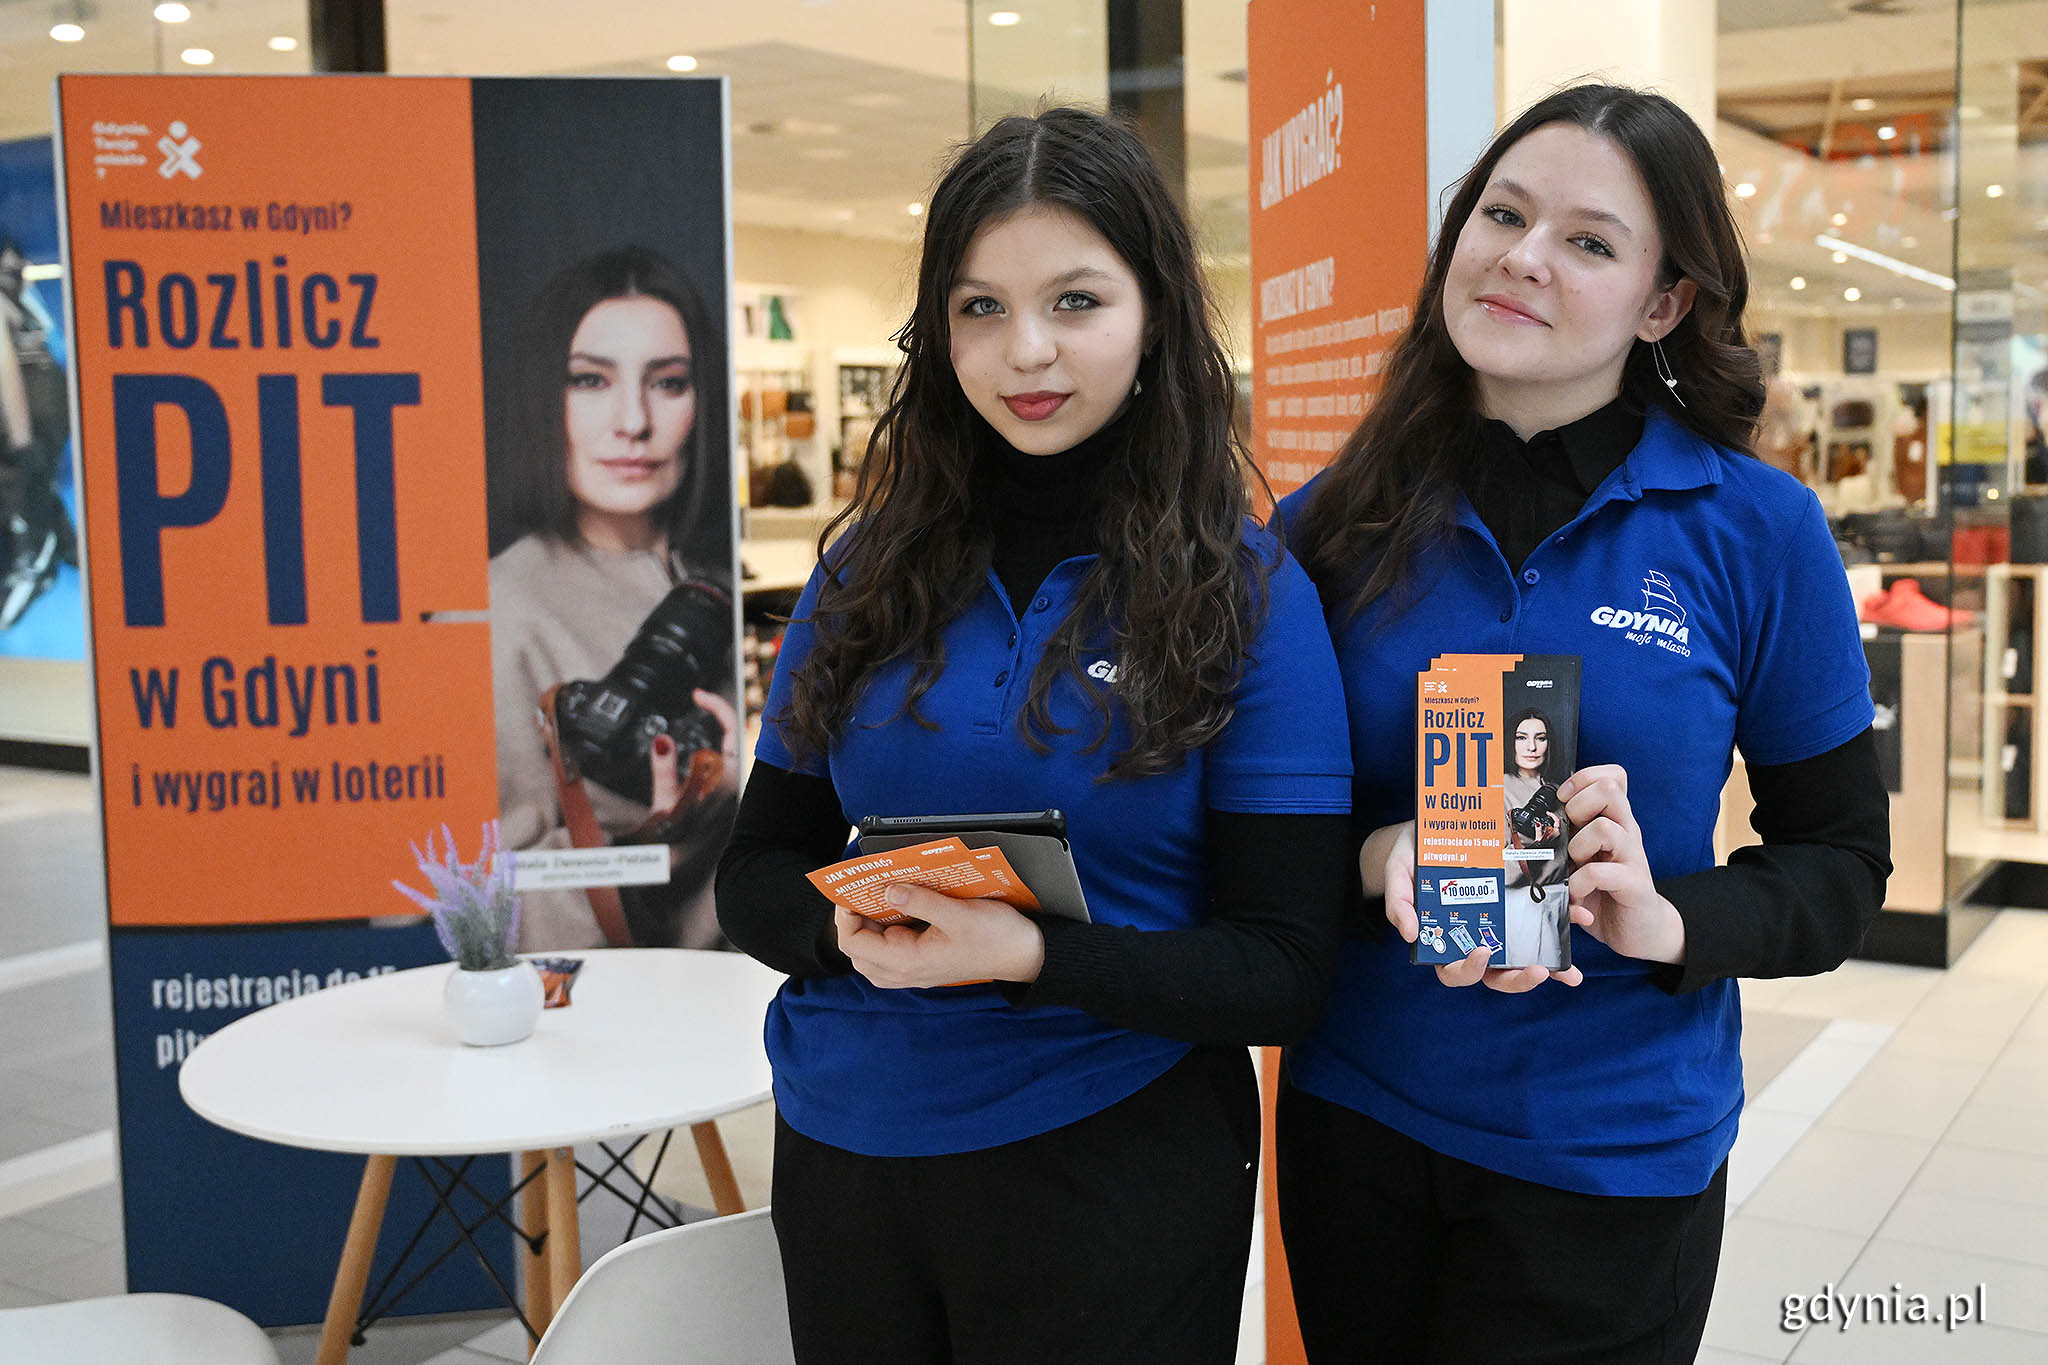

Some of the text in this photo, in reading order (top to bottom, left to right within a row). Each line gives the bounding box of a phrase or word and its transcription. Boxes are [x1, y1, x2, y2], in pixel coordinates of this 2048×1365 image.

[100, 201, 352, 236] Mieszkasz w Gdyni?
[103, 256, 380, 350] Rozlicz
[112, 372, 422, 628] PIT
[1590, 606, 1689, 645] GDYNIA
[1625, 631, 1691, 658] moje miasto
[129, 649, 381, 737] w Gdyni
[1424, 708, 1485, 728] Rozlicz
[1425, 732, 1493, 787] PIT
[132, 755, 445, 812] i wygraj w loterii
[1425, 792, 1482, 812] w Gdyni
[1429, 819, 1458, 831] wygraj
[1460, 820, 1468, 830] w
[1469, 819, 1496, 831] loterii
[825, 871, 846, 884] JAK
